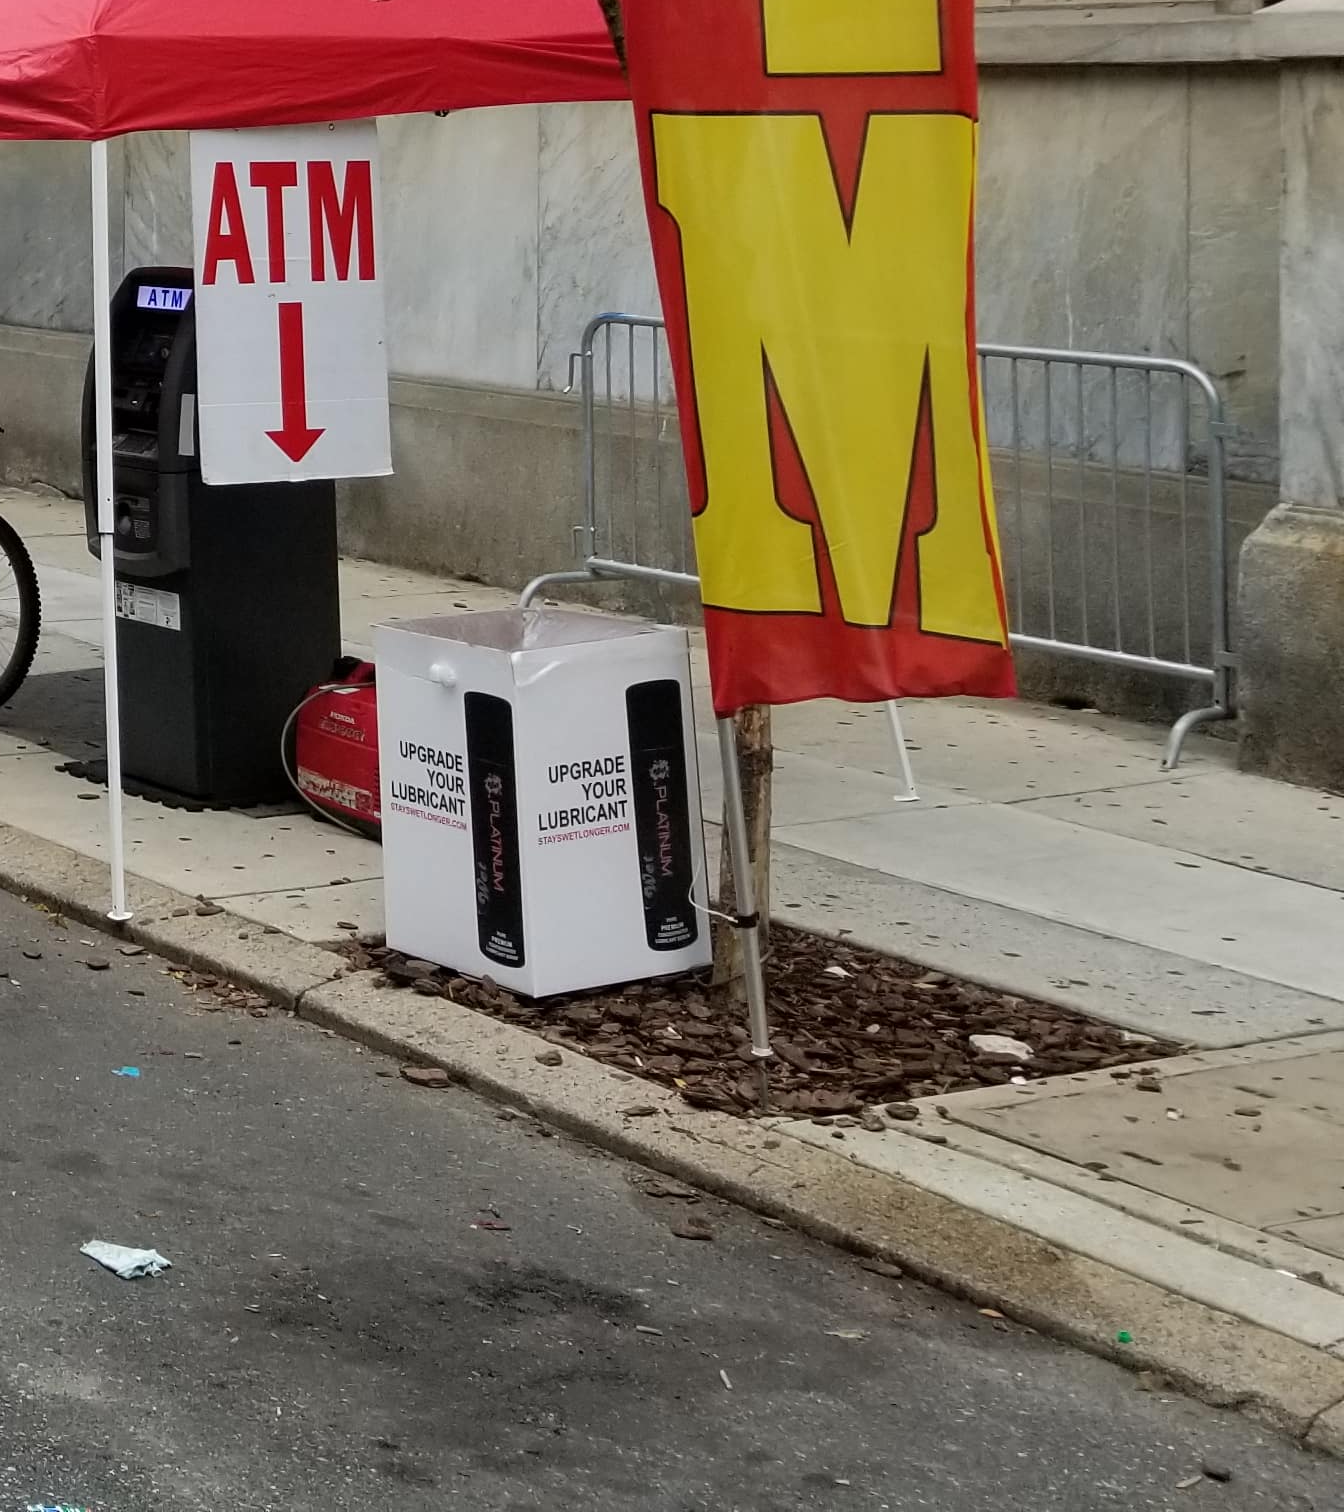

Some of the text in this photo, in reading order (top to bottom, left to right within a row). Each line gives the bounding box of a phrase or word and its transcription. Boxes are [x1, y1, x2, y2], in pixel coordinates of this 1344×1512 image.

[202, 161, 376, 285] ATM
[147, 289, 183, 308] ATM
[399, 740, 464, 773] UPGRADE
[548, 755, 626, 784] UPGRADE
[426, 768, 465, 795] YOUR
[581, 778, 627, 801] YOUR
[391, 780, 466, 817] LUBRICANT
[538, 800, 628, 831] LUBRICANT
[489, 800, 505, 892] PLATINUM
[538, 822, 630, 846] STAYSWETLONGER.COM
[654, 786, 673, 877] PLATINUM
